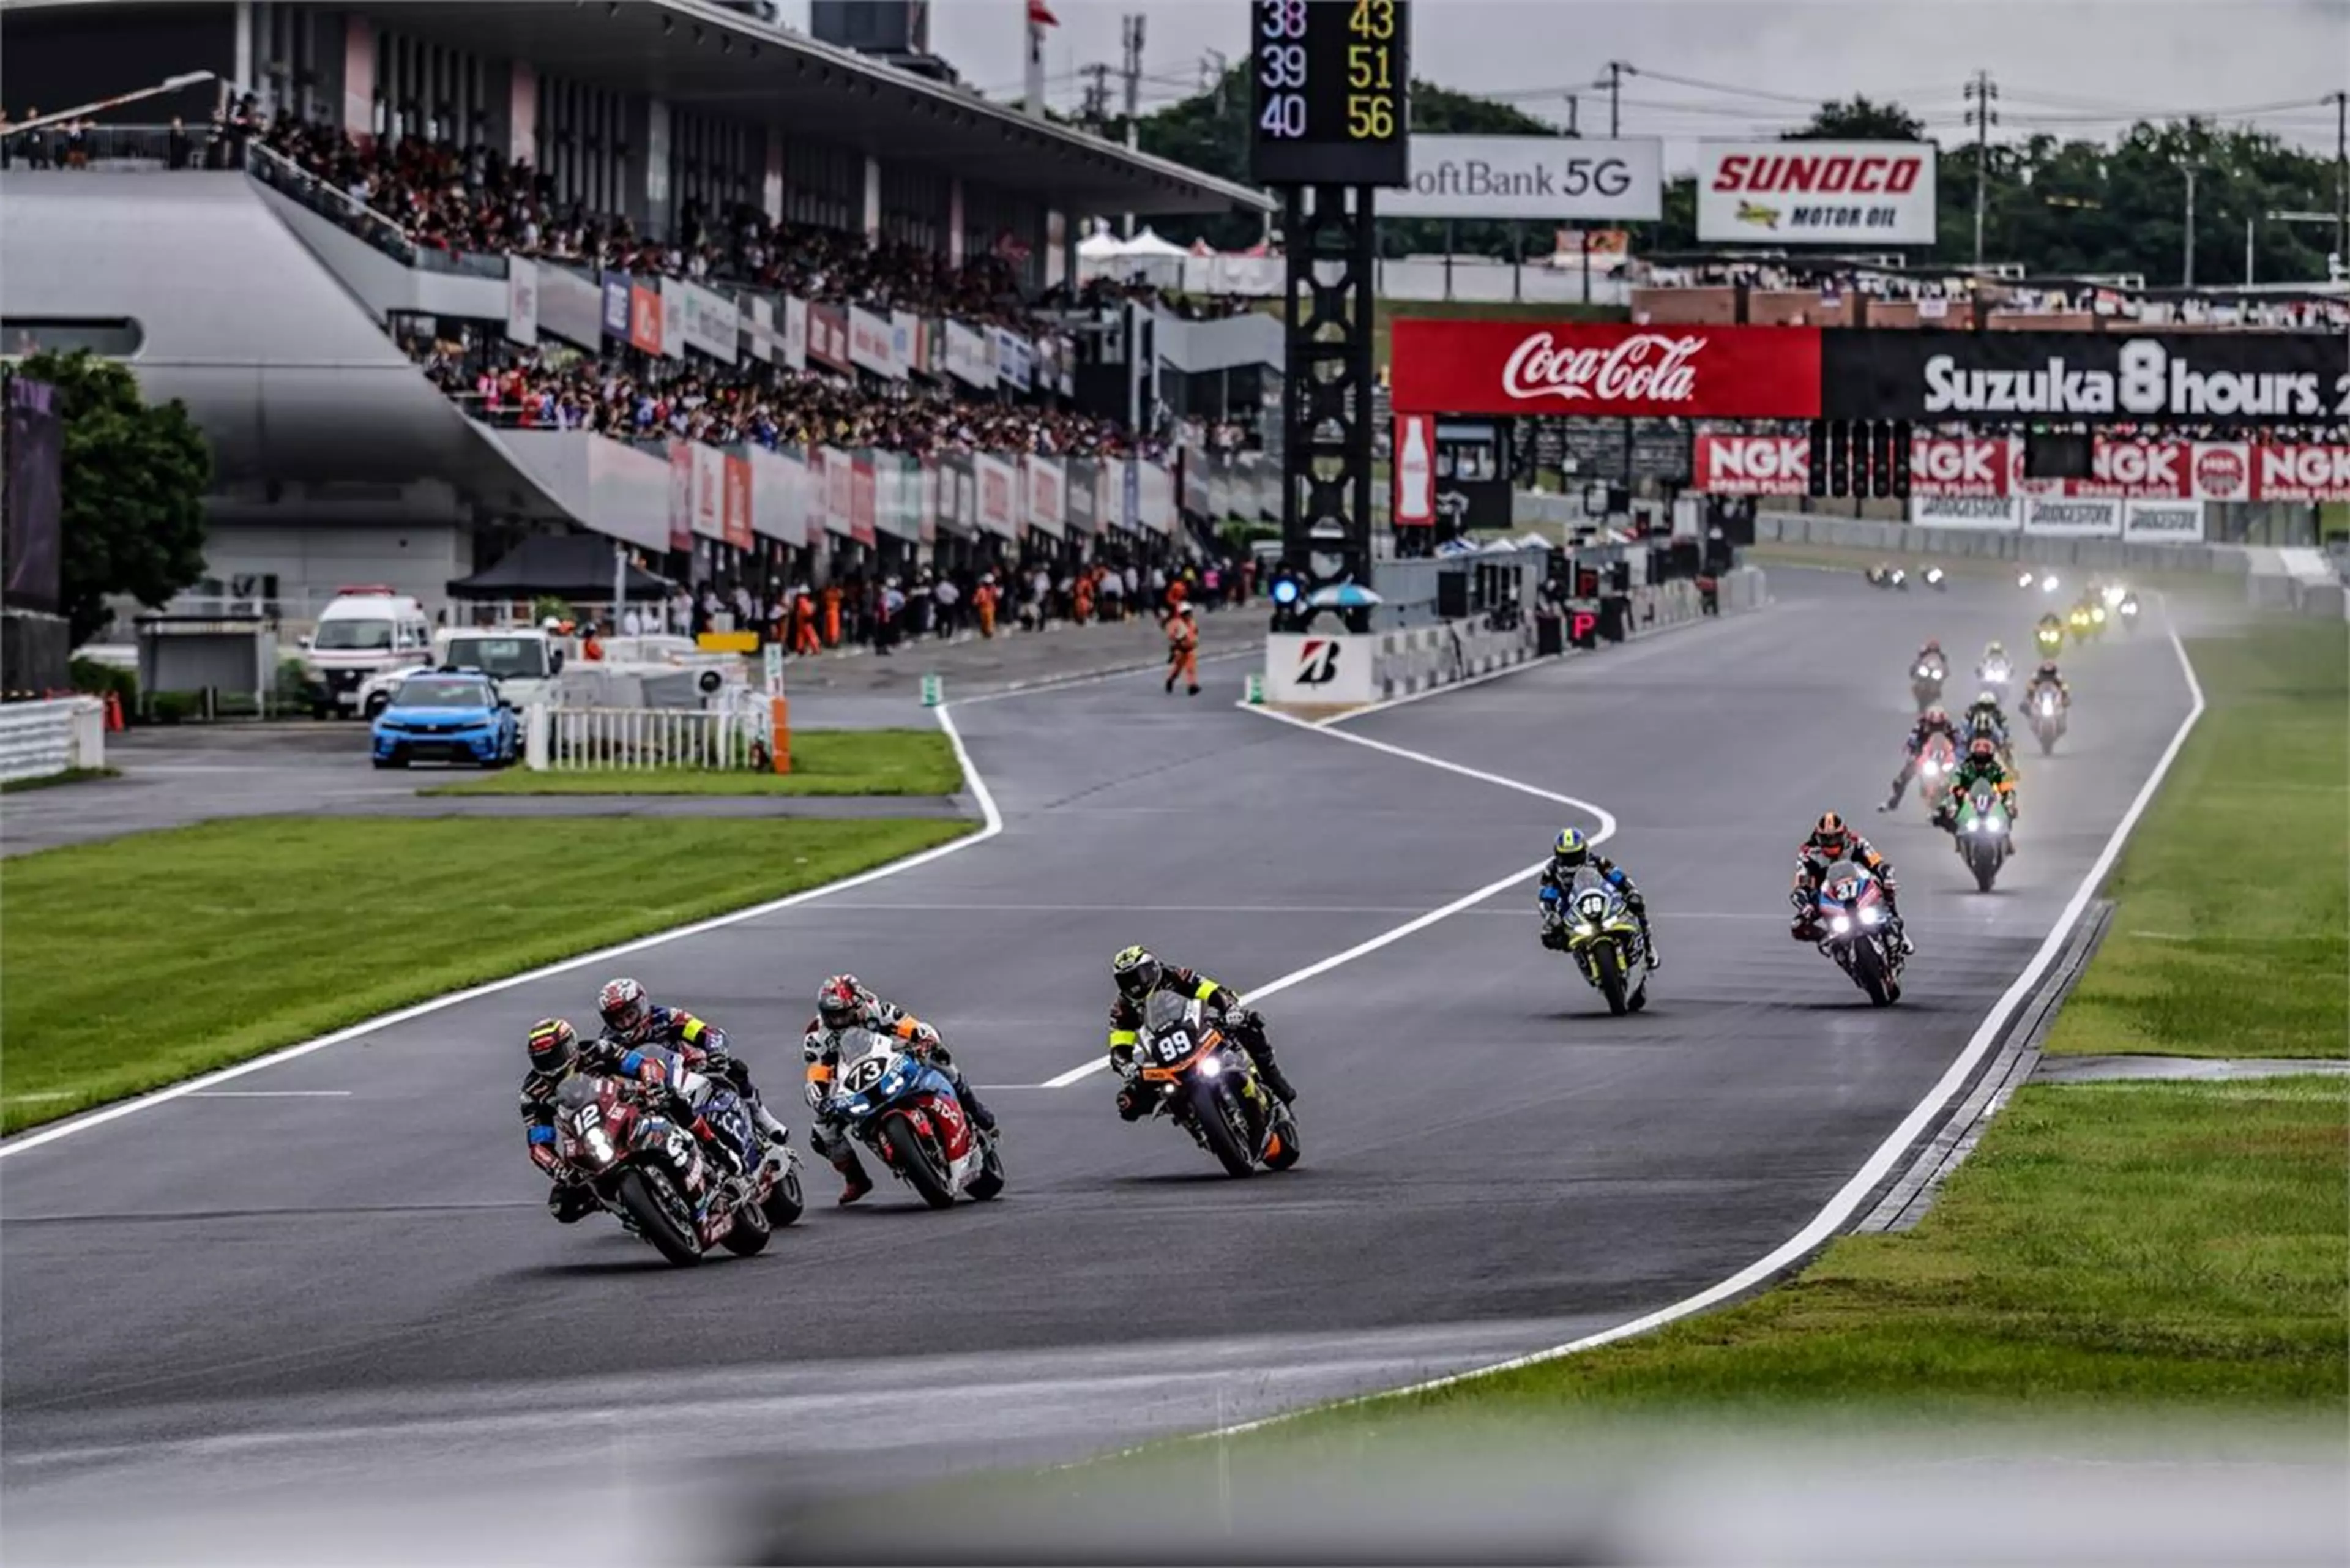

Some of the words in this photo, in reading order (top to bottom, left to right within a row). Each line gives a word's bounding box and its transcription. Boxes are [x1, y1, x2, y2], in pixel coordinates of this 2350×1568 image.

[1262, 0, 1307, 39] 38
[1349, 0, 1394, 39] 43
[1261, 45, 1307, 88] 39
[1348, 45, 1393, 89] 51
[1261, 93, 1307, 138] 40
[1348, 94, 1394, 138] 56
[1394, 160, 1556, 196] oftBank
[1564, 157, 1632, 197] 5G
[1712, 155, 1922, 193] SUNOCO
[1790, 206, 1863, 228] MOTOR
[1866, 207, 1897, 228] OIL
[1502, 331, 1708, 400] Coca-Cola
[1925, 354, 2114, 413] Suzuka
[2118, 338, 2167, 413] 8
[1710, 438, 1810, 477] NGK
[1573, 614, 1595, 640] P
[1158, 1029, 1192, 1062] 99
[849, 1060, 881, 1091] 73
[573, 1103, 600, 1137] 12
